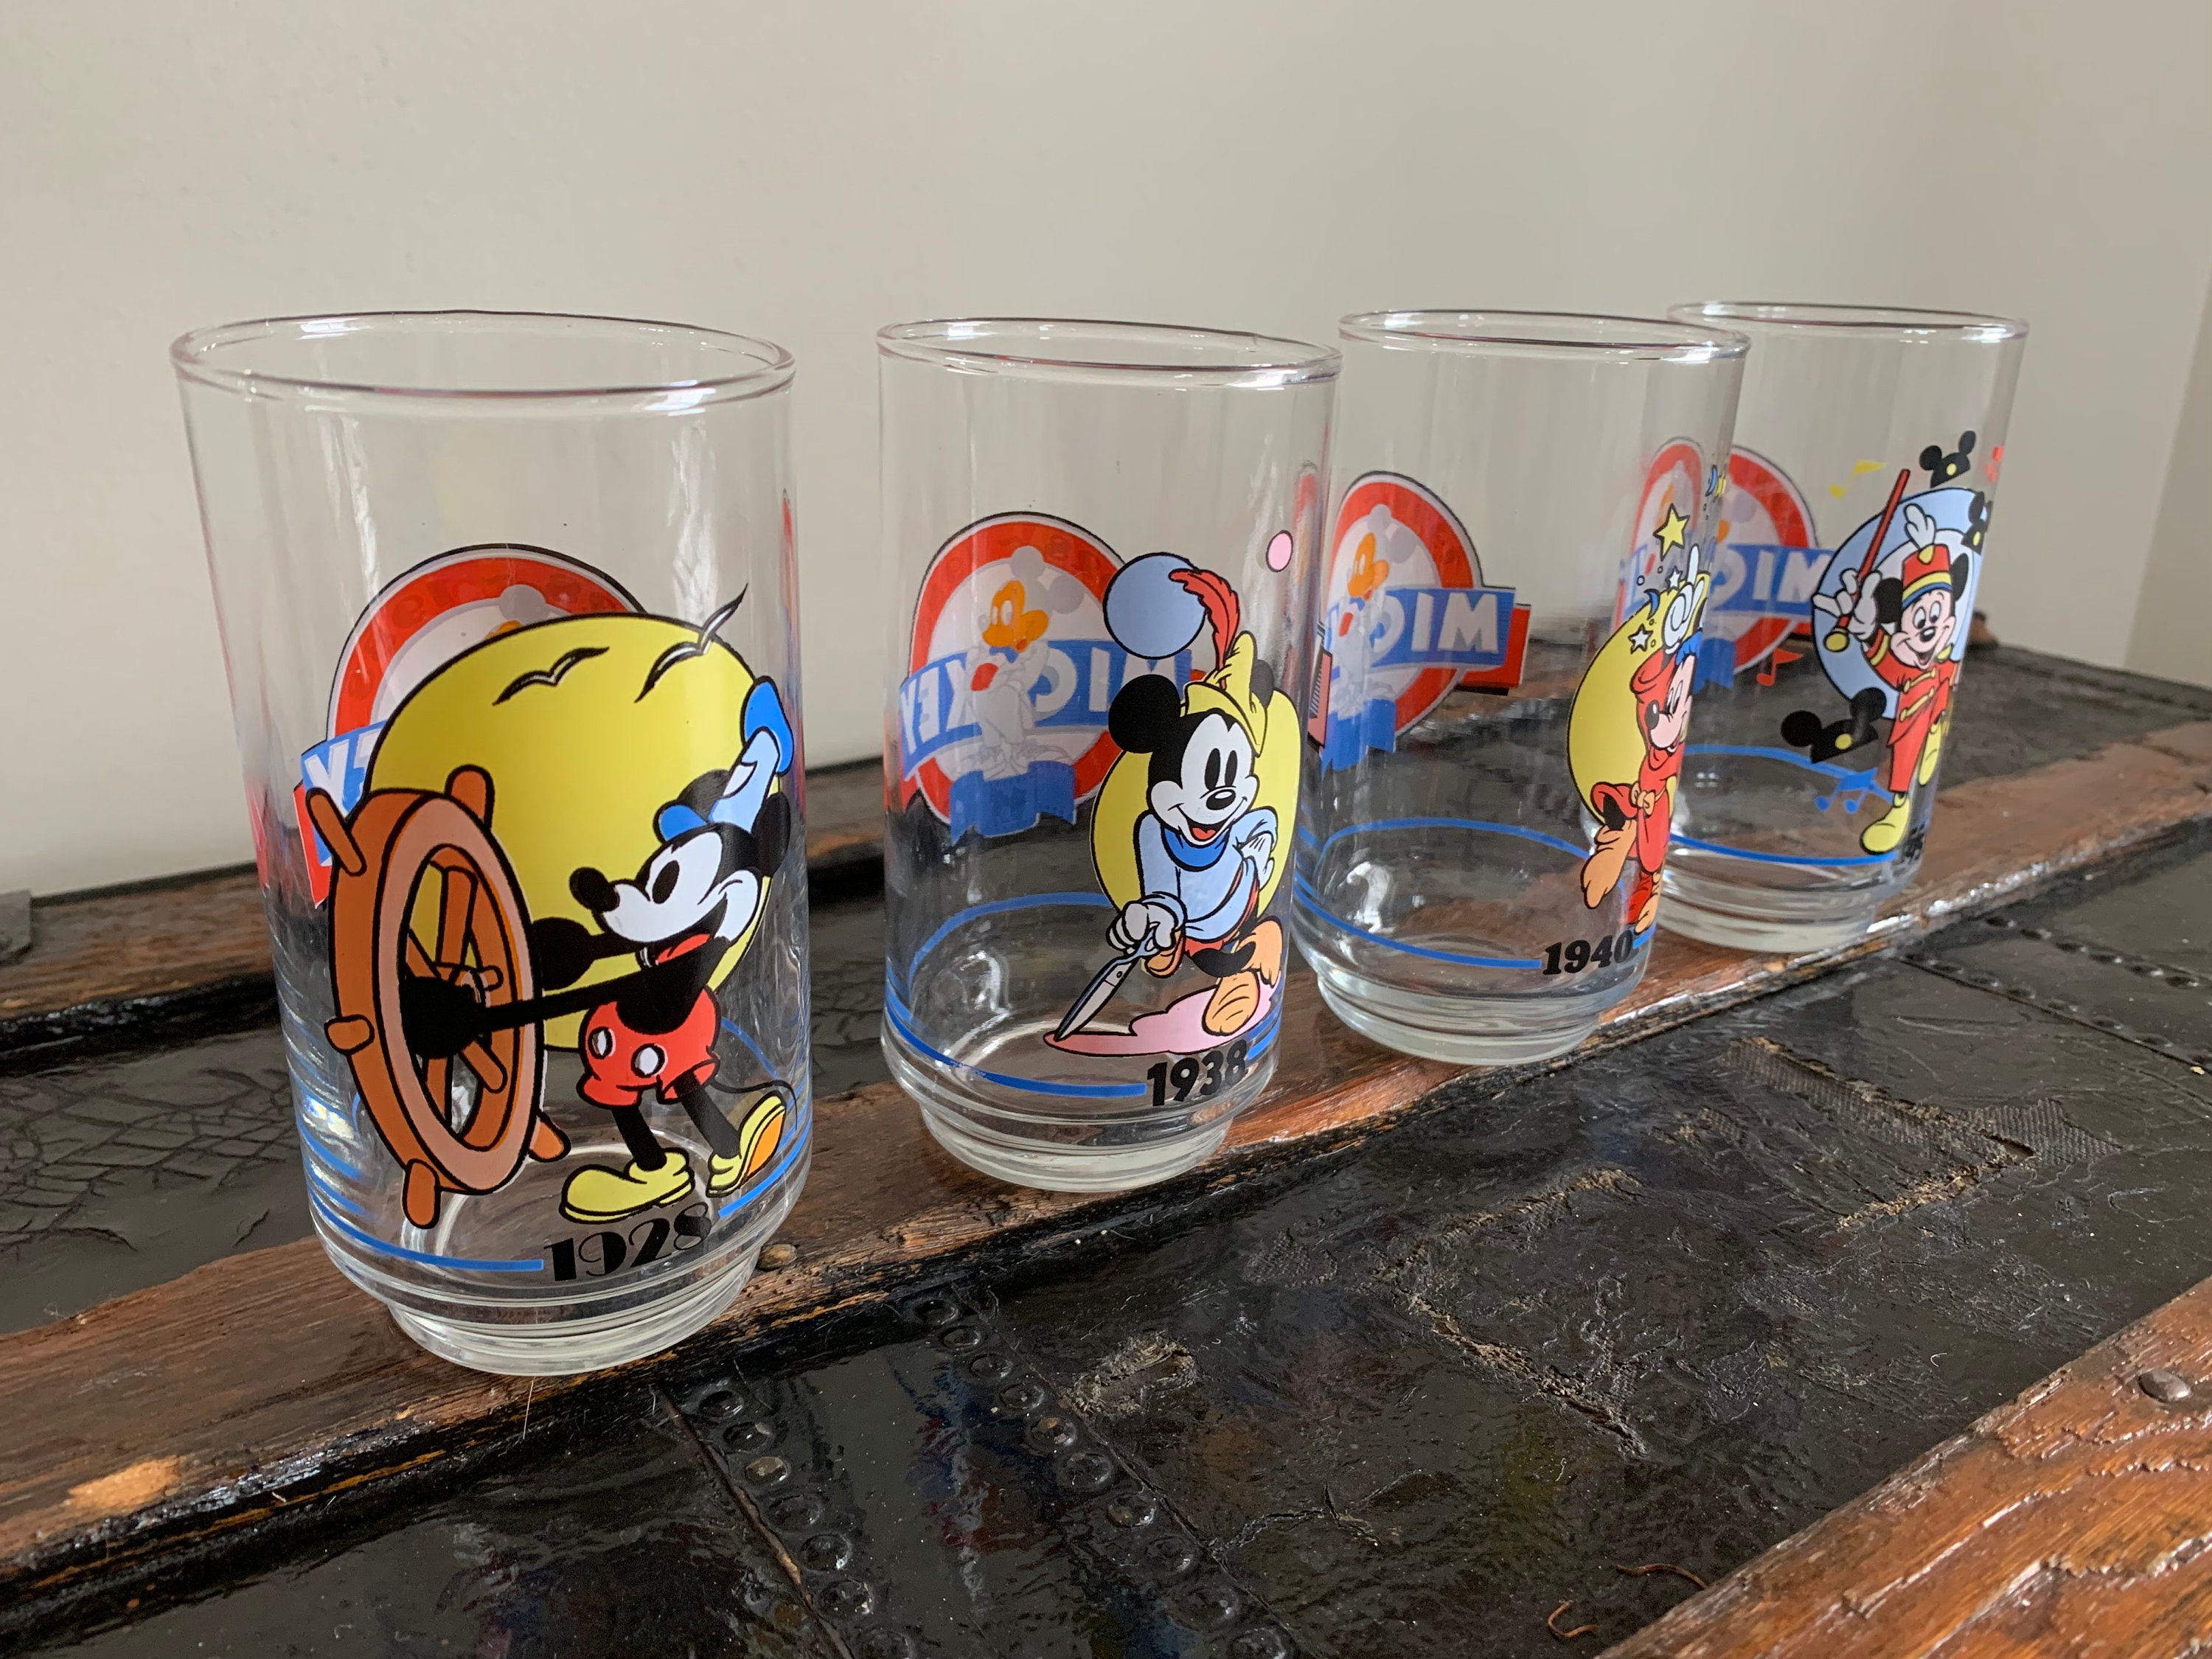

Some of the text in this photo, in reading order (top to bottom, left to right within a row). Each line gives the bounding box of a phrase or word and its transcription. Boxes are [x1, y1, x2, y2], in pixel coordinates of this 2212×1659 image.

[1543, 930, 1633, 975] 1940
[1147, 1040, 1248, 1106] 1938
[543, 1202, 712, 1281] 1928
